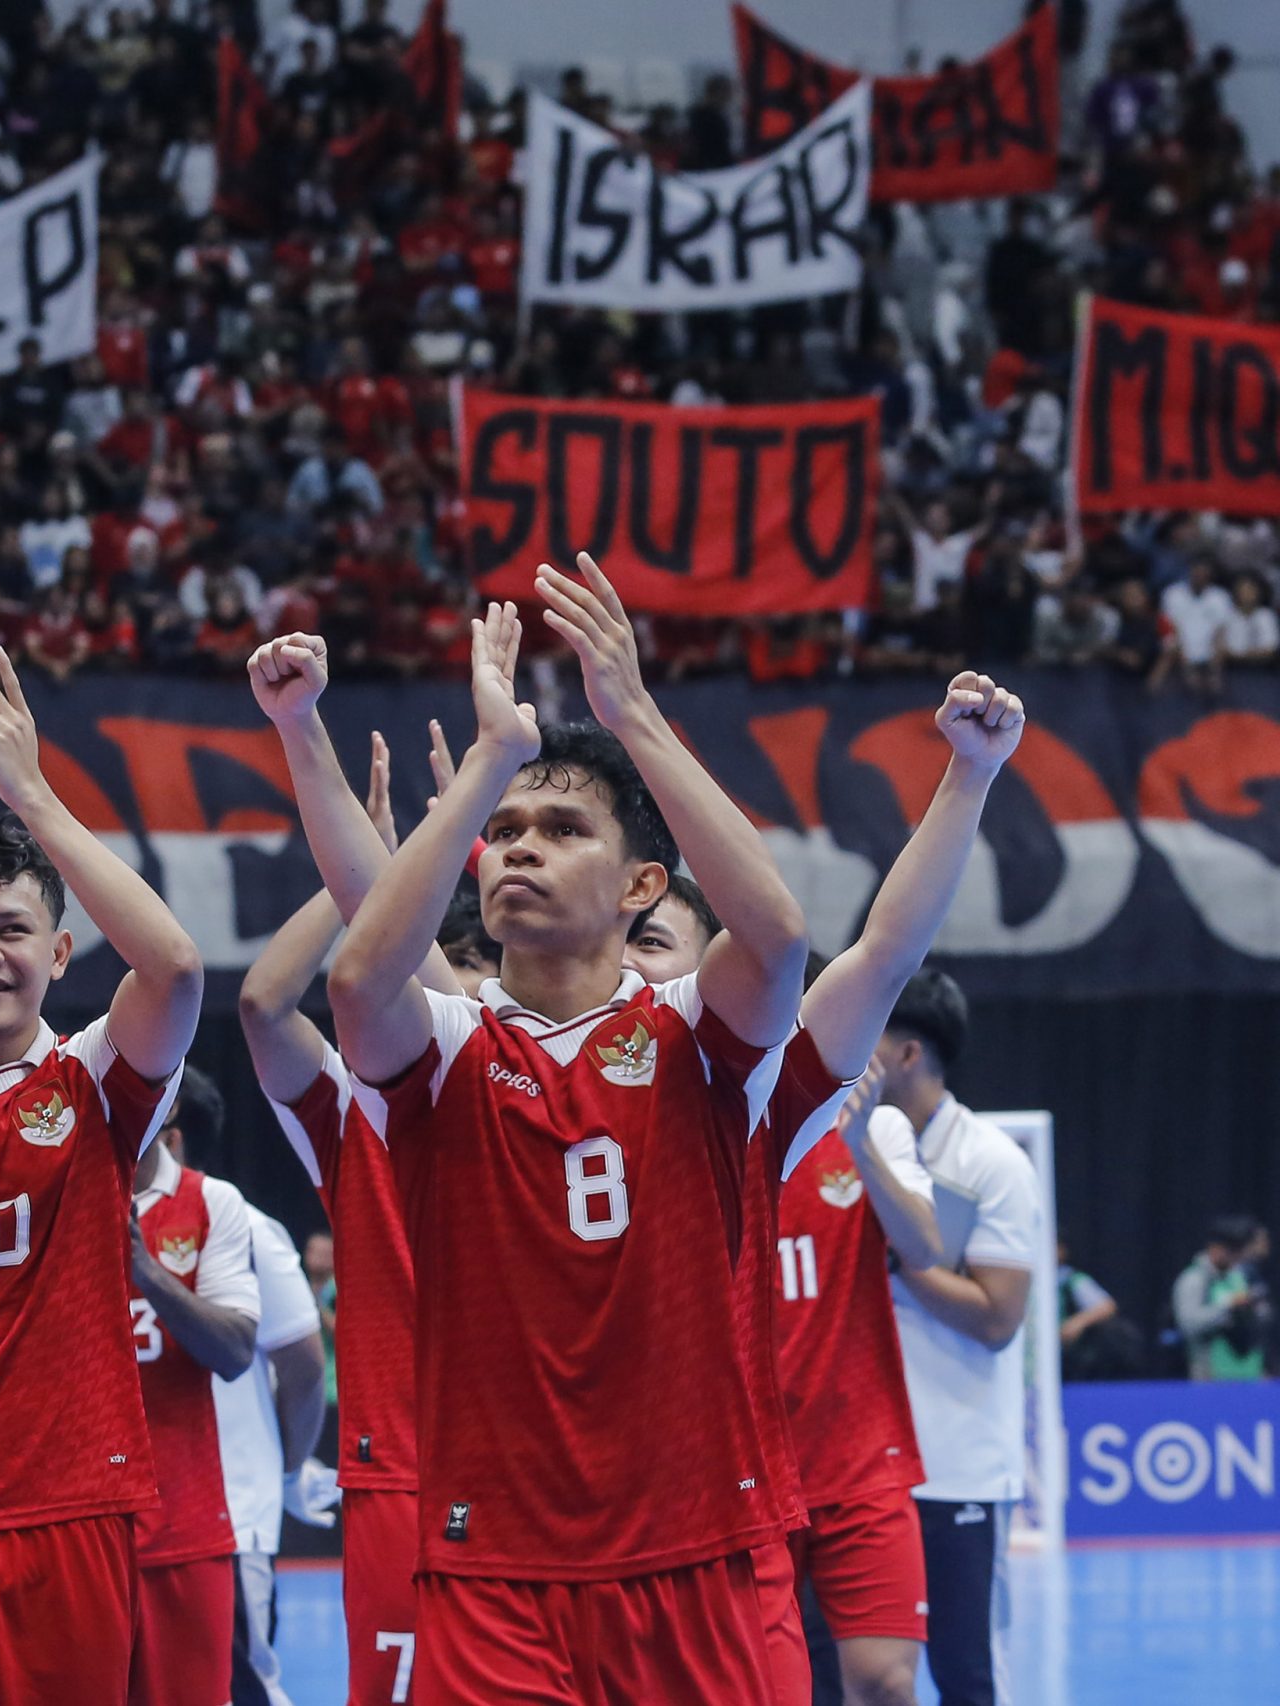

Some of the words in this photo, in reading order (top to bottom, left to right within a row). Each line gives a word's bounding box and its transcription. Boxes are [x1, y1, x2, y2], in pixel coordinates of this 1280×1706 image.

[547, 117, 863, 287] ISRAR
[470, 409, 866, 583] SOUTO
[487, 1061, 541, 1098] SPECS
[564, 1136, 631, 1242] 8
[777, 1234, 819, 1301] 11
[375, 1630, 416, 1704] 7
